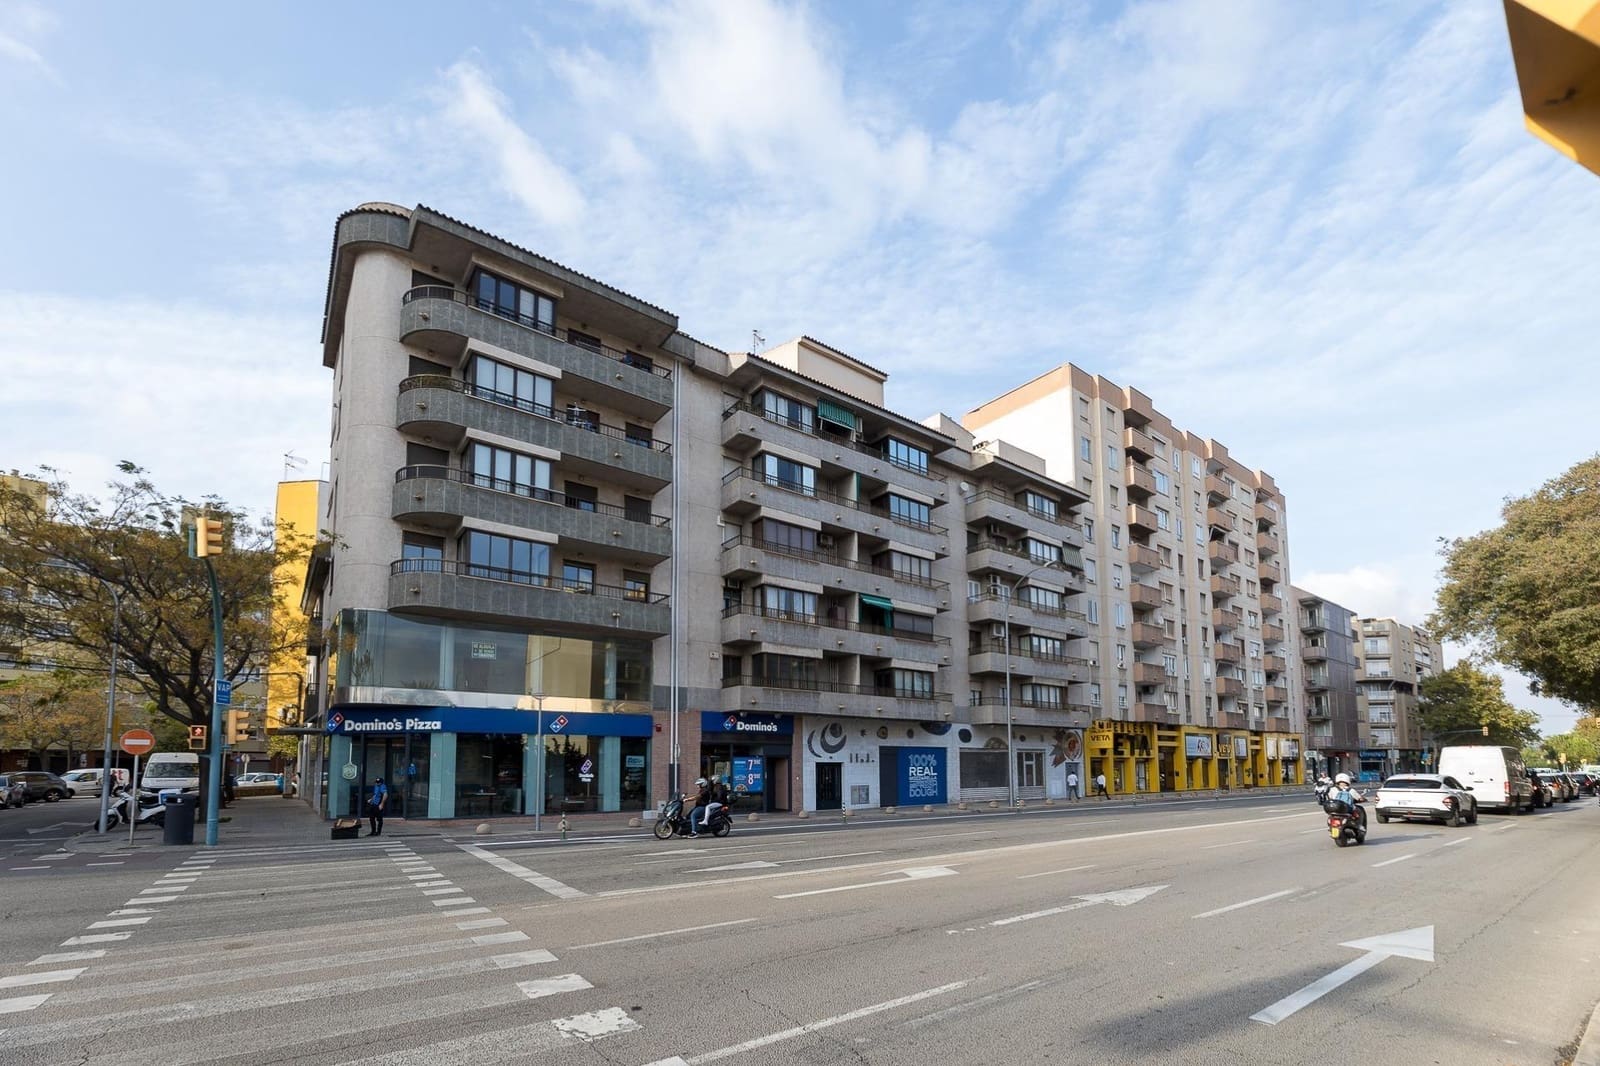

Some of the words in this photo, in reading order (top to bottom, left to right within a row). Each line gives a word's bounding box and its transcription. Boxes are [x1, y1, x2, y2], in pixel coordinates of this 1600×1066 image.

[344, 718, 403, 731] Domino's
[405, 718, 441, 730] Pizza
[736, 721, 778, 732] Domino's
[747, 759, 753, 770] 7
[908, 754, 937, 767] 100%
[909, 766, 938, 776] REAL
[747, 773, 754, 785] 8
